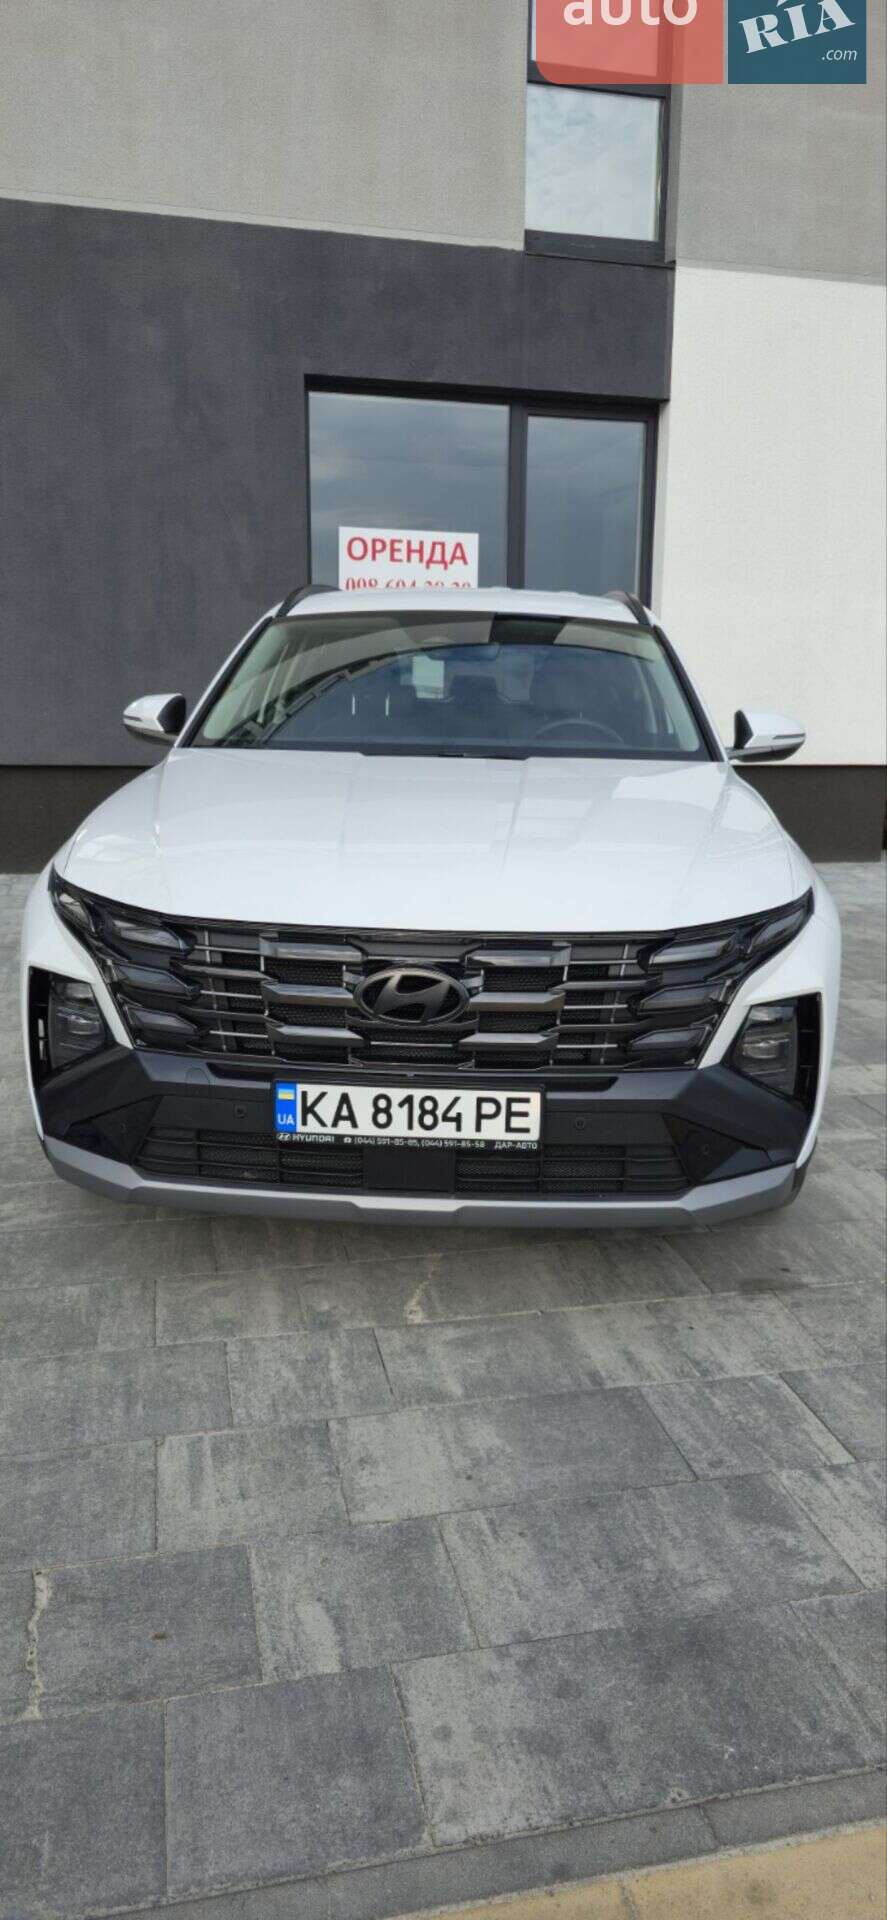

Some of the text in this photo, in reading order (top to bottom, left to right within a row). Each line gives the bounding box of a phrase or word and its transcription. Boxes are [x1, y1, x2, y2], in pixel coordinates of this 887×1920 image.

[346, 536, 469, 571] ОРЕНДА
[300, 1090, 532, 1134] KA 8184 PE
[277, 1114, 296, 1126] UA
[292, 1134, 335, 1144] HYUNDAI
[494, 1141, 538, 1150] ДАР-АВТО
